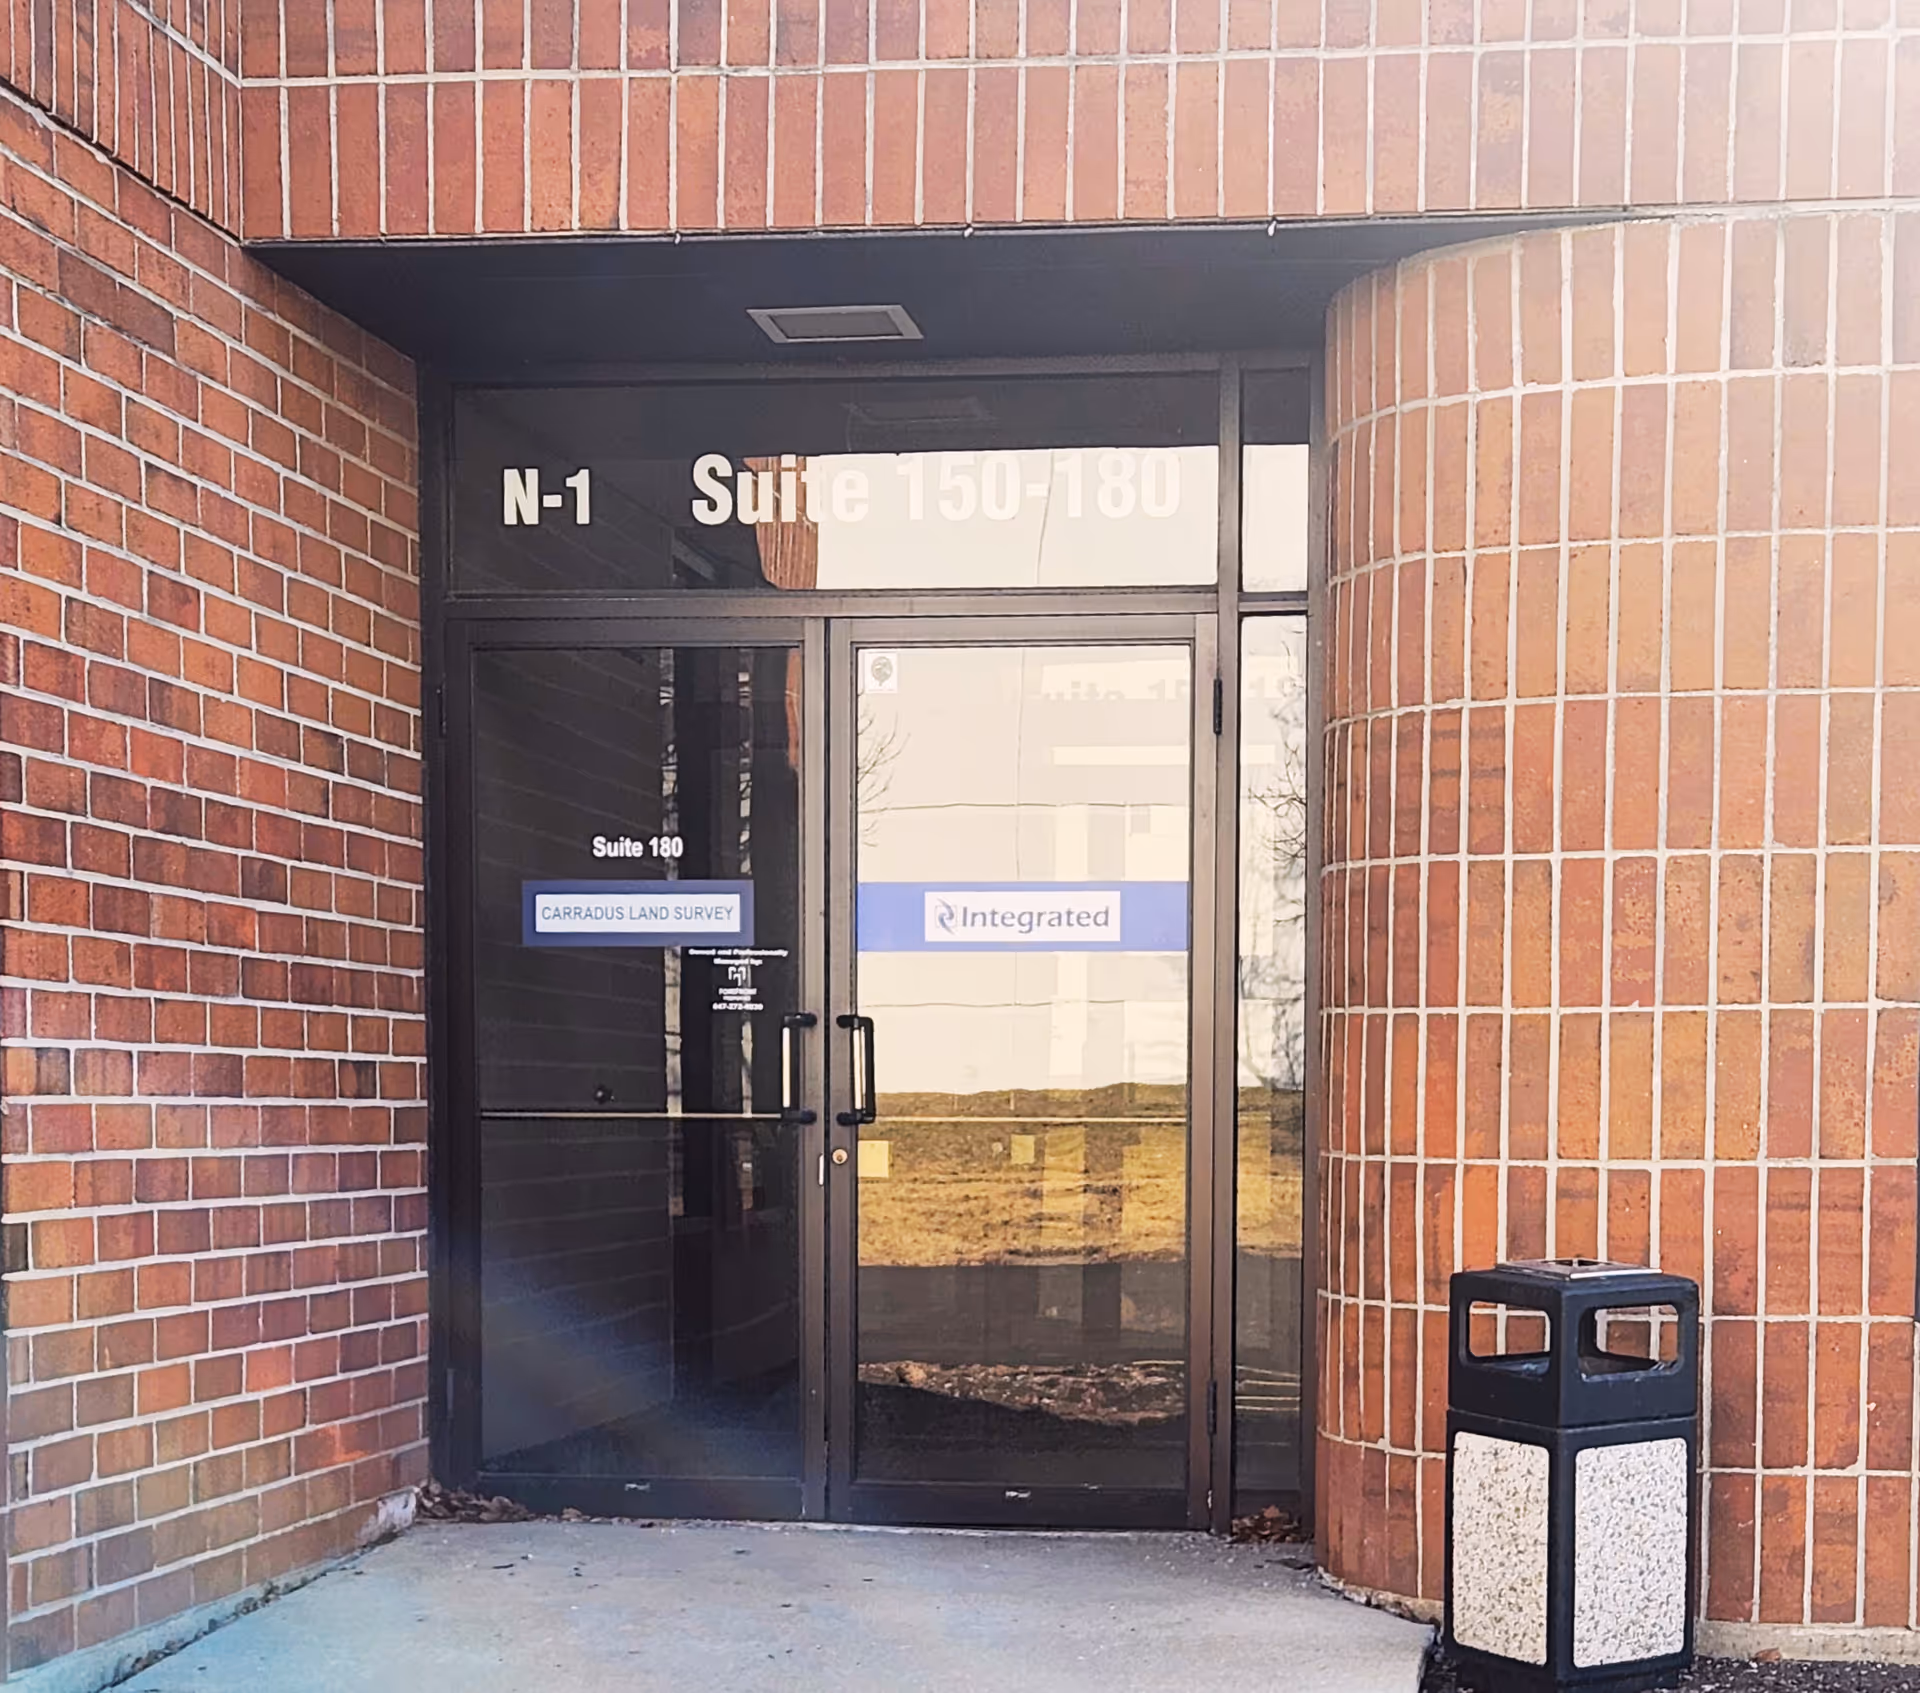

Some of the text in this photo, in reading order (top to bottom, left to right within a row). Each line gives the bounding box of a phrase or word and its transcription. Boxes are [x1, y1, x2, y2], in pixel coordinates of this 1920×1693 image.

[503, 467, 590, 525] N-1
[692, 450, 1181, 525] Suite 150-180
[592, 835, 684, 858] Suite 180
[541, 905, 735, 921] CARRADUS LAND SURVEY
[961, 904, 1111, 935] Integrated
